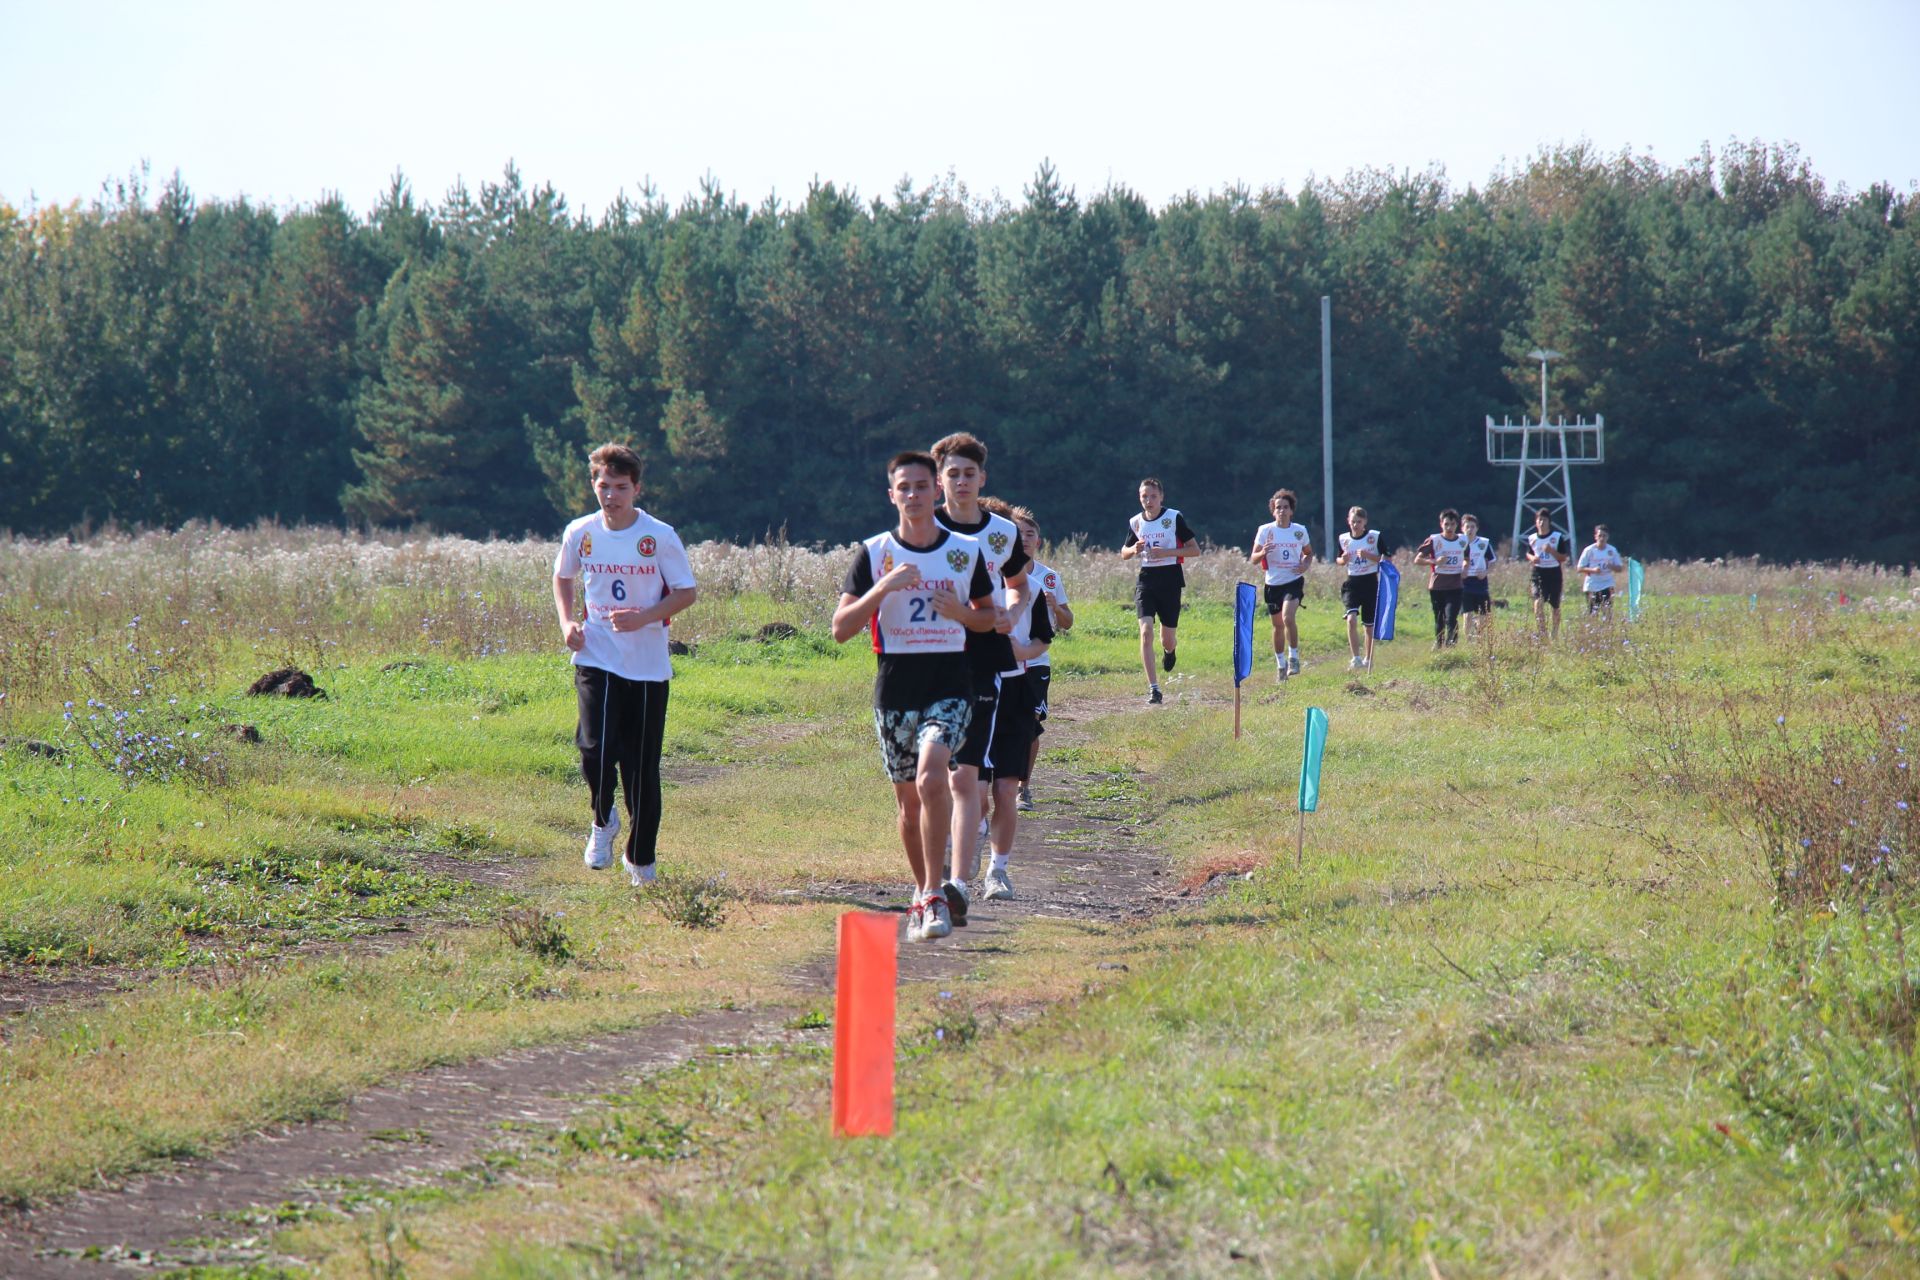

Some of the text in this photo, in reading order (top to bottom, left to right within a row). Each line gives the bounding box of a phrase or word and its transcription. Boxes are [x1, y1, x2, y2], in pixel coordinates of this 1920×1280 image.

[1282, 549, 1290, 560] 9
[1446, 556, 1458, 565] 28
[584, 563, 655, 575] ТАТАРСТАН
[611, 579, 626, 601] 6
[909, 597, 938, 623] 27
